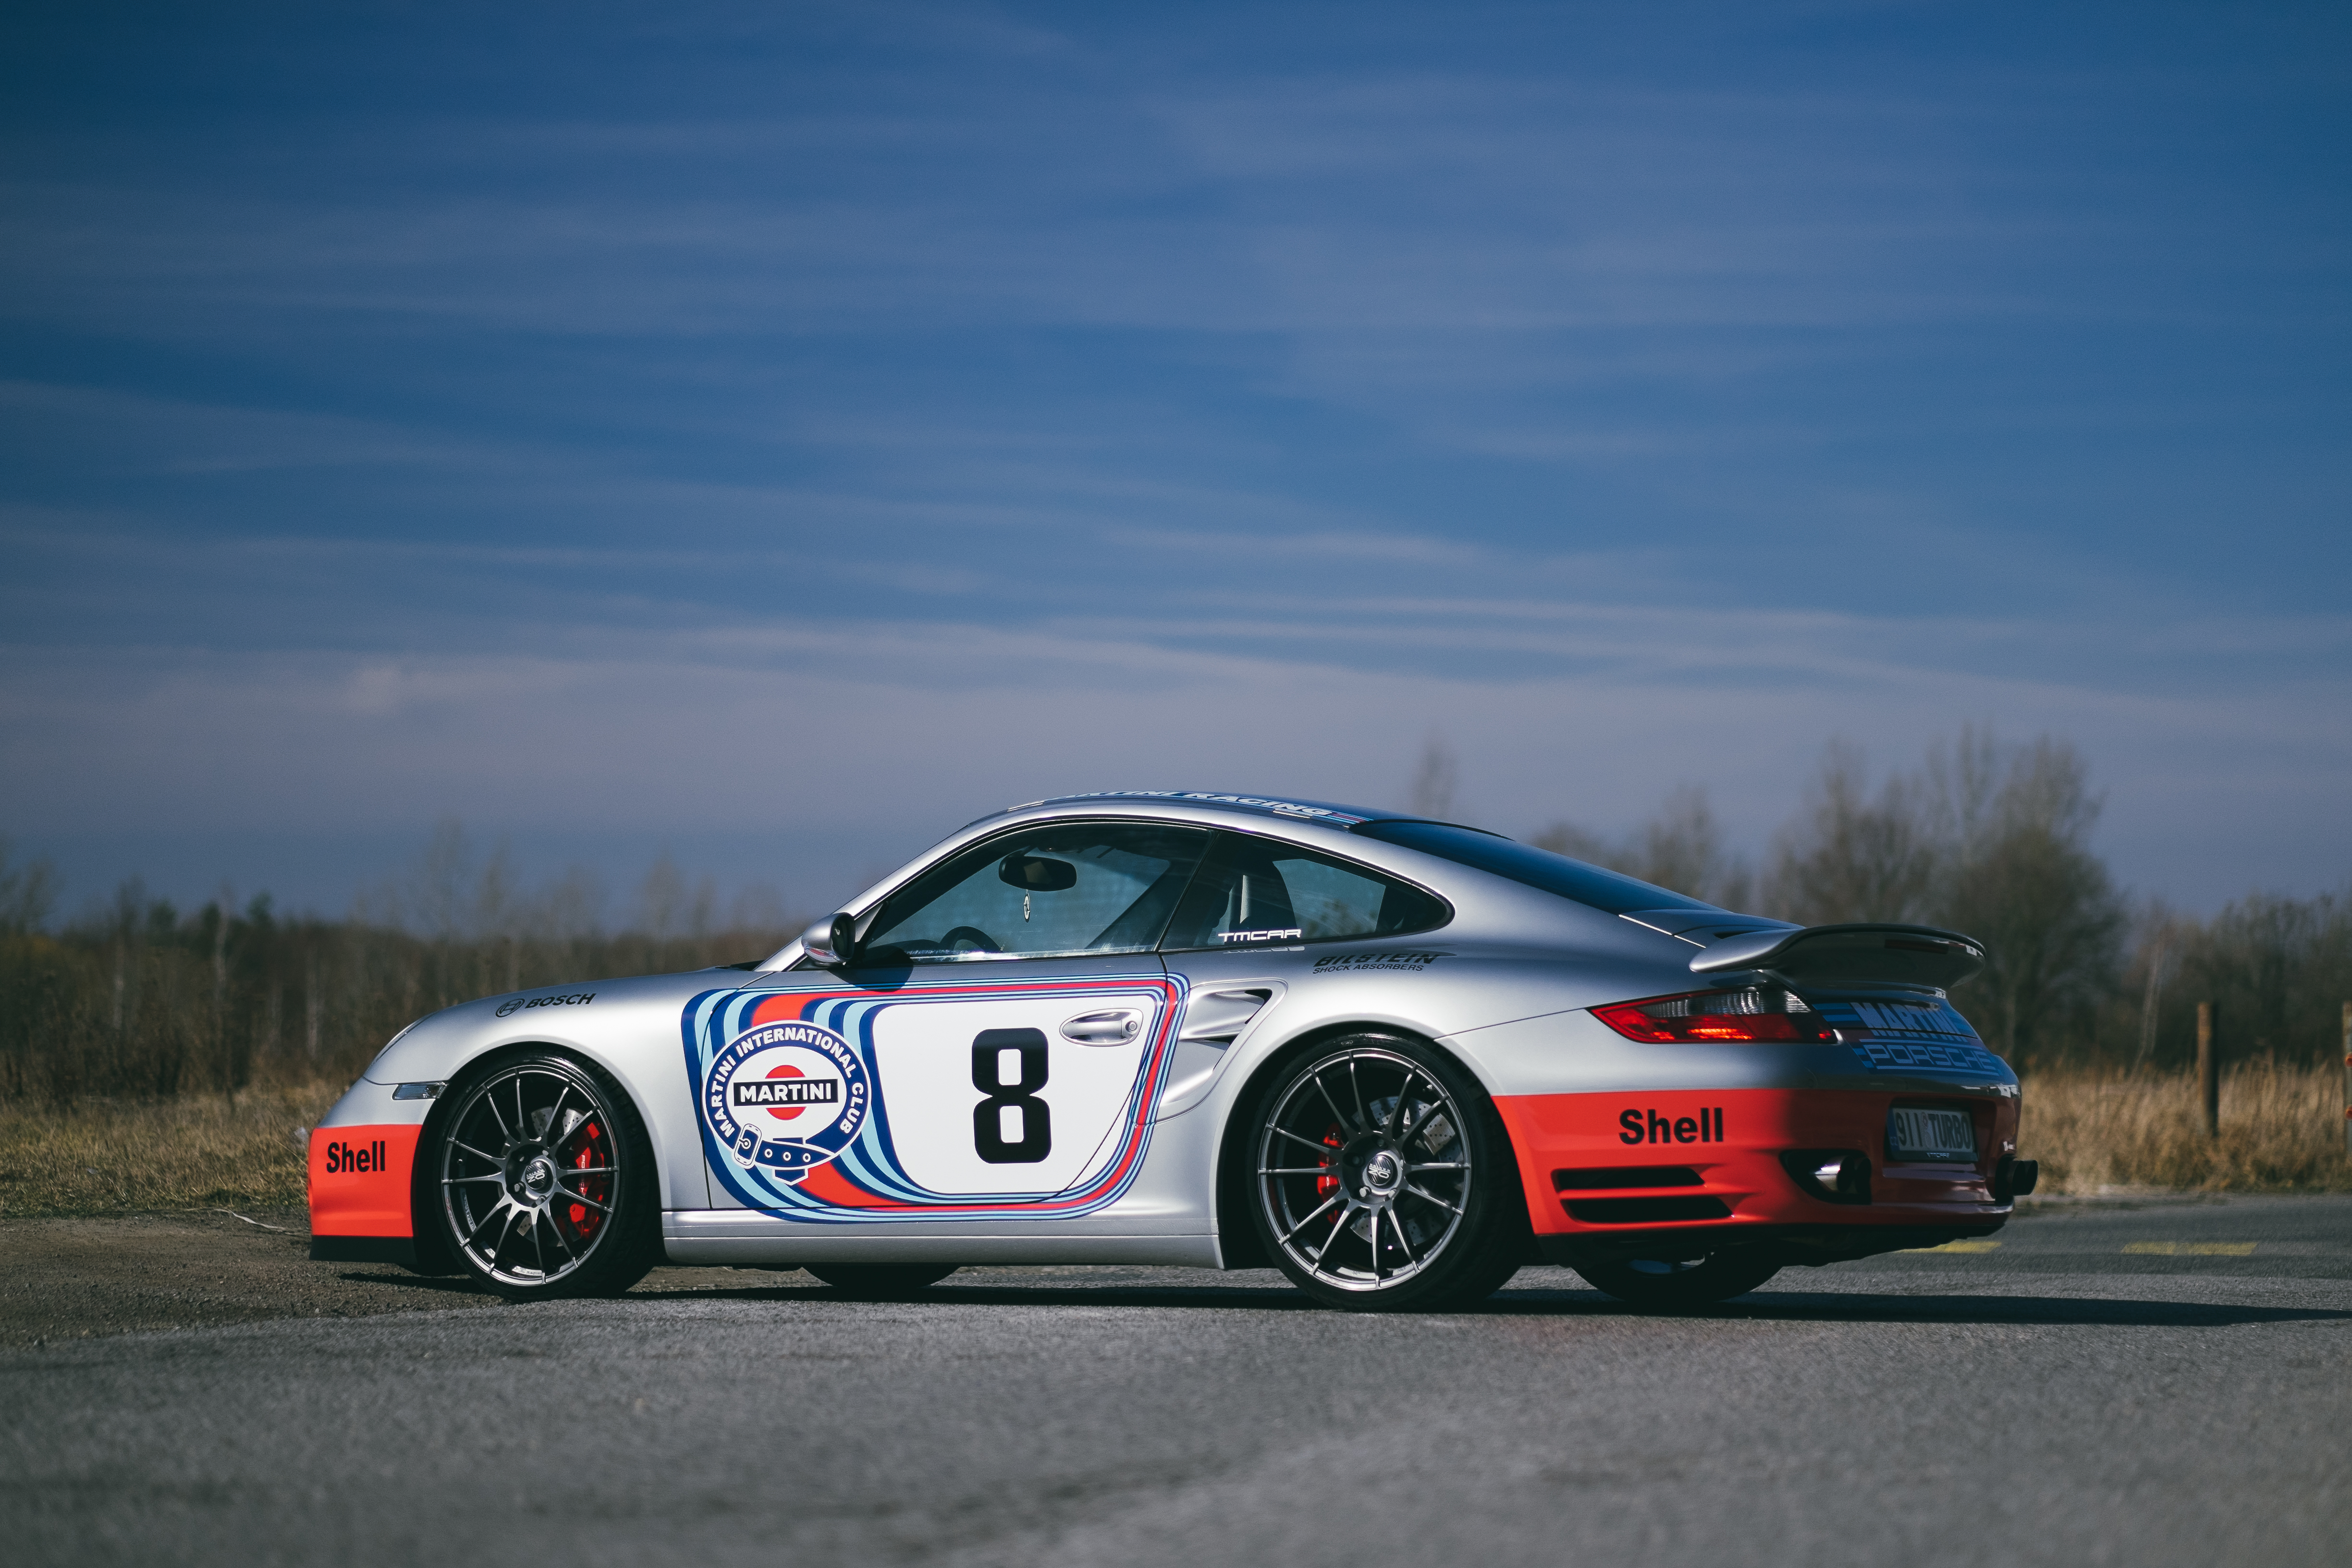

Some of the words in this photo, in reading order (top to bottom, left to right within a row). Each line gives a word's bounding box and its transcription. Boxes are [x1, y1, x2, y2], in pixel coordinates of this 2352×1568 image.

[1183, 793, 1333, 815] RACING
[1218, 929, 1301, 942] TMCAR
[1312, 965, 1352, 974] SHOCK
[1313, 954, 1440, 968] BILSTEIN
[525, 993, 597, 1008] BOSCH
[1850, 1002, 1968, 1042] MARTINI
[1863, 1044, 1997, 1070] PORSCHE
[711, 1054, 736, 1138] MARTINI
[735, 1027, 856, 1078] INTERNATIONAL
[840, 1082, 864, 1134] CLUB
[740, 1083, 832, 1102] MARTINI
[972, 1027, 1052, 1164] 8
[1618, 1107, 1724, 1144] Shell
[1928, 1113, 1972, 1149] TURBO
[326, 1140, 386, 1173] Shell
